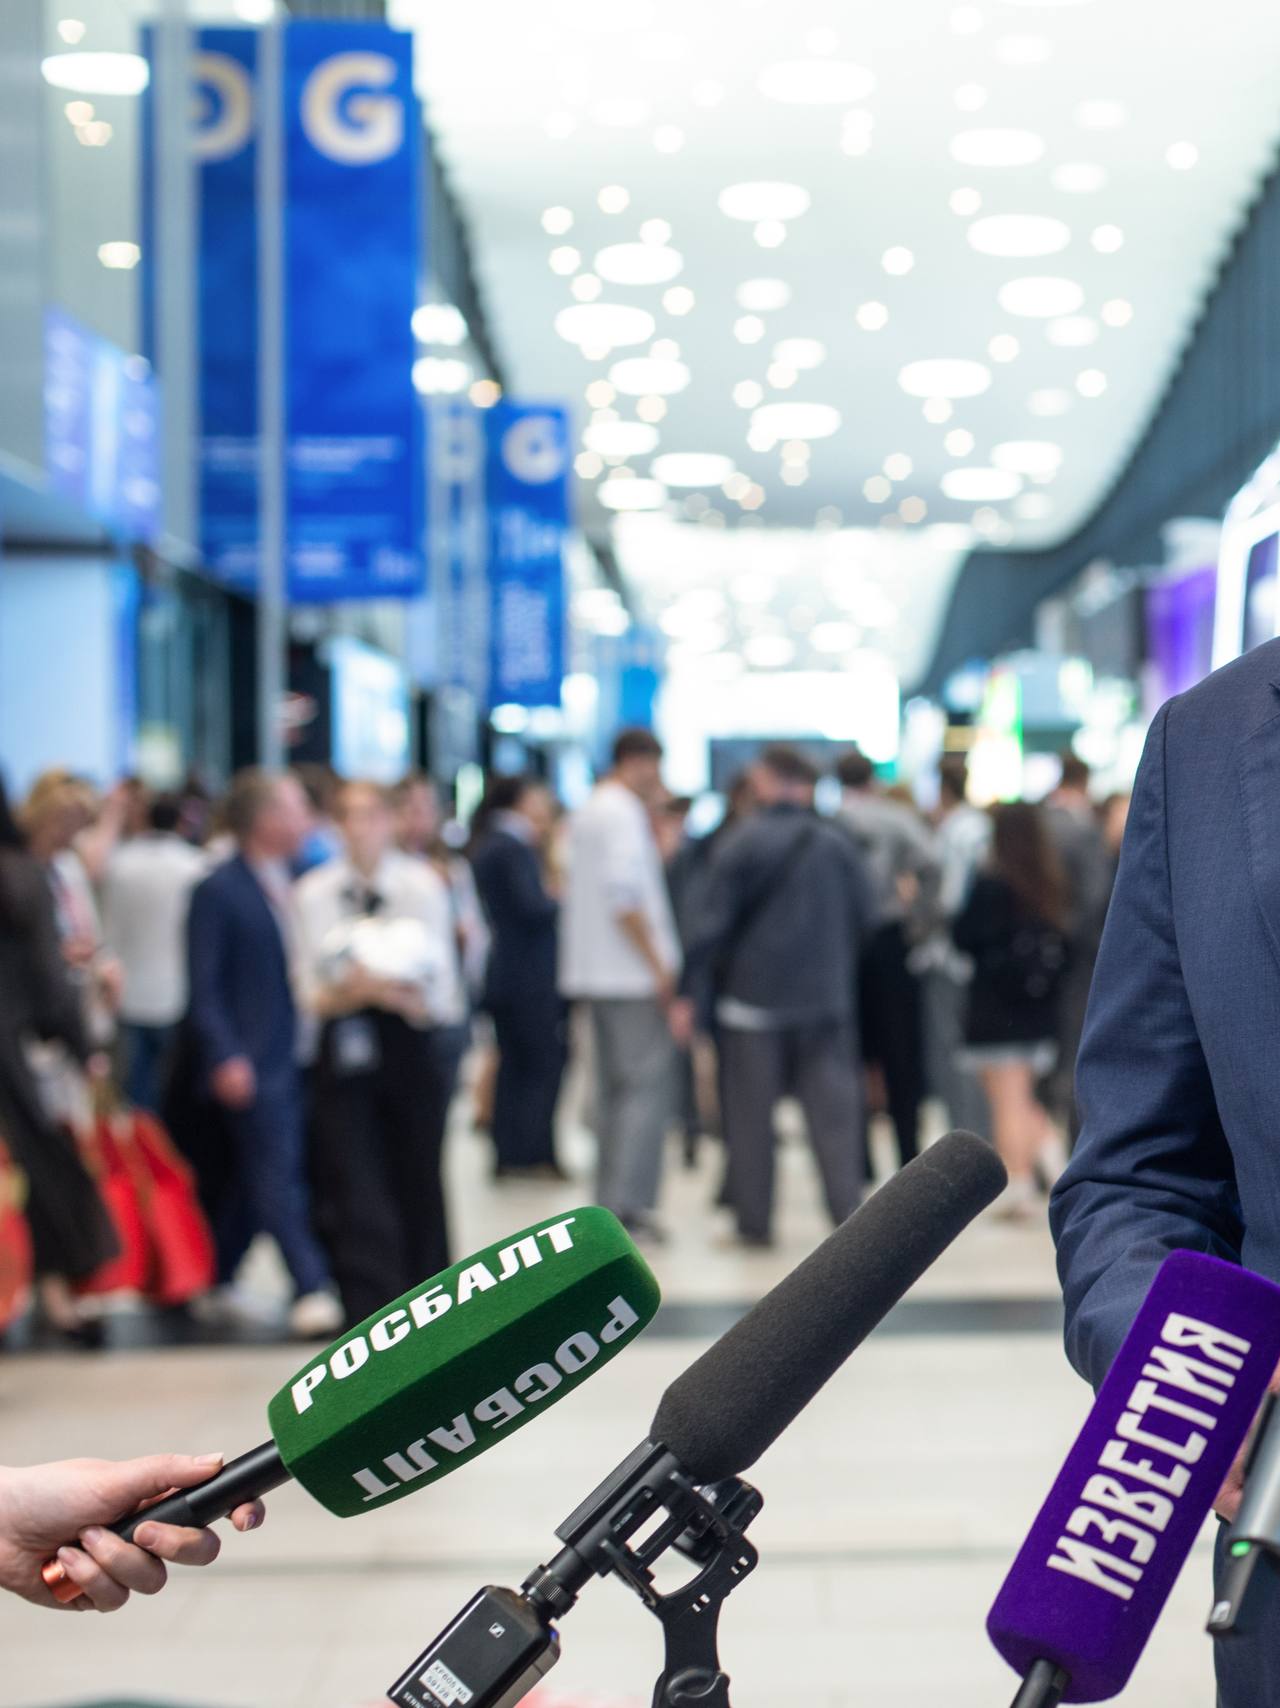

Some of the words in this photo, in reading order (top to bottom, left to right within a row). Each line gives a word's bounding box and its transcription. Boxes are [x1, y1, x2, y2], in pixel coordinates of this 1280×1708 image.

[291, 1217, 576, 1415] РОСБАЛТ
[352, 1295, 640, 1502] РОСБАЛТ
[1047, 1312, 1251, 1600] ИЗВЕСТИЯ
